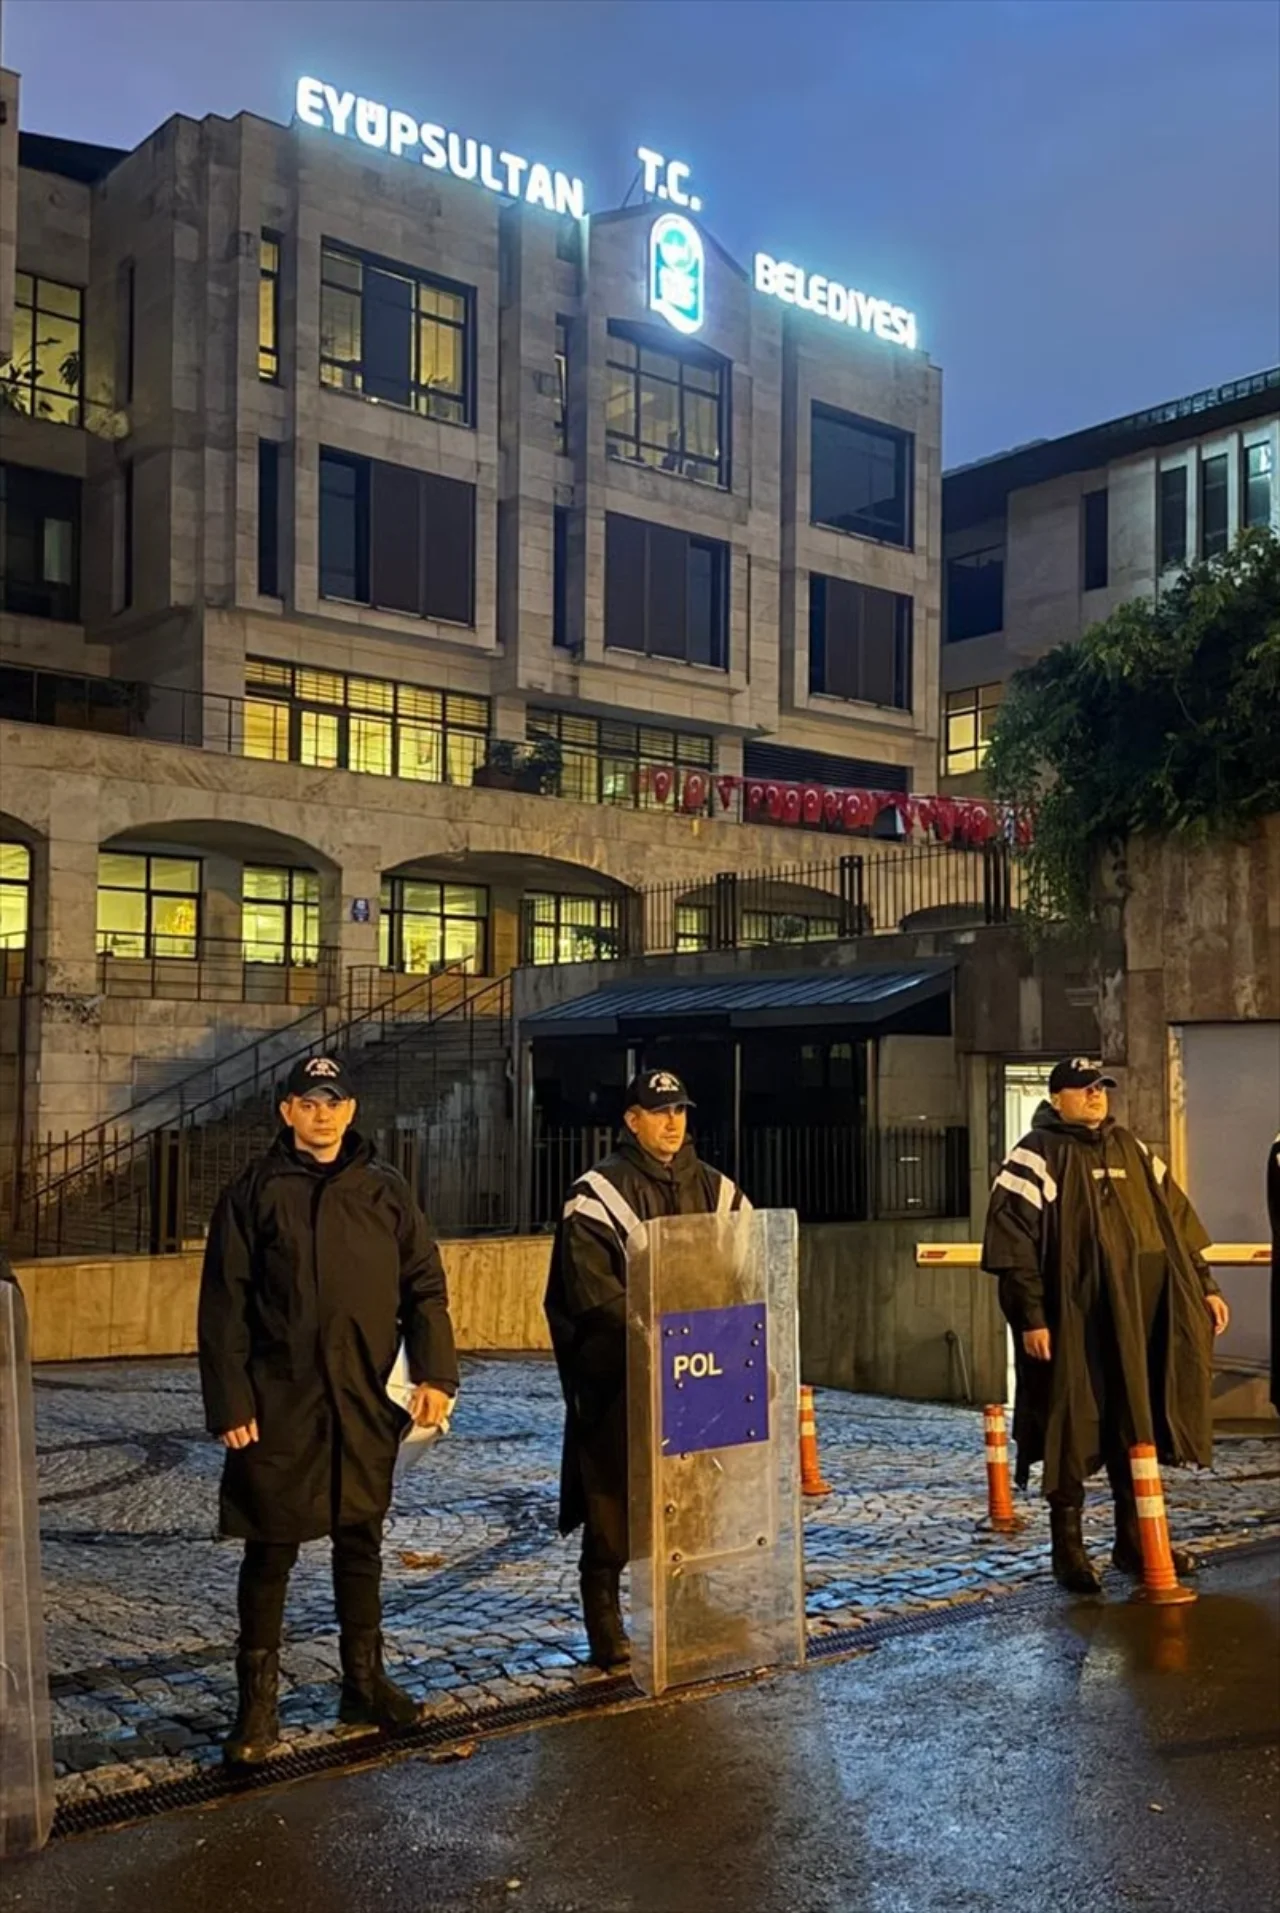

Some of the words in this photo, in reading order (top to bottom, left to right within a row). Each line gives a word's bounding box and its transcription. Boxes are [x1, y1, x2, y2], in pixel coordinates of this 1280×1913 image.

[296, 75, 584, 219] EYÜPSULTAN
[638, 147, 702, 211] T.C.
[673, 1352, 723, 1380] POL
